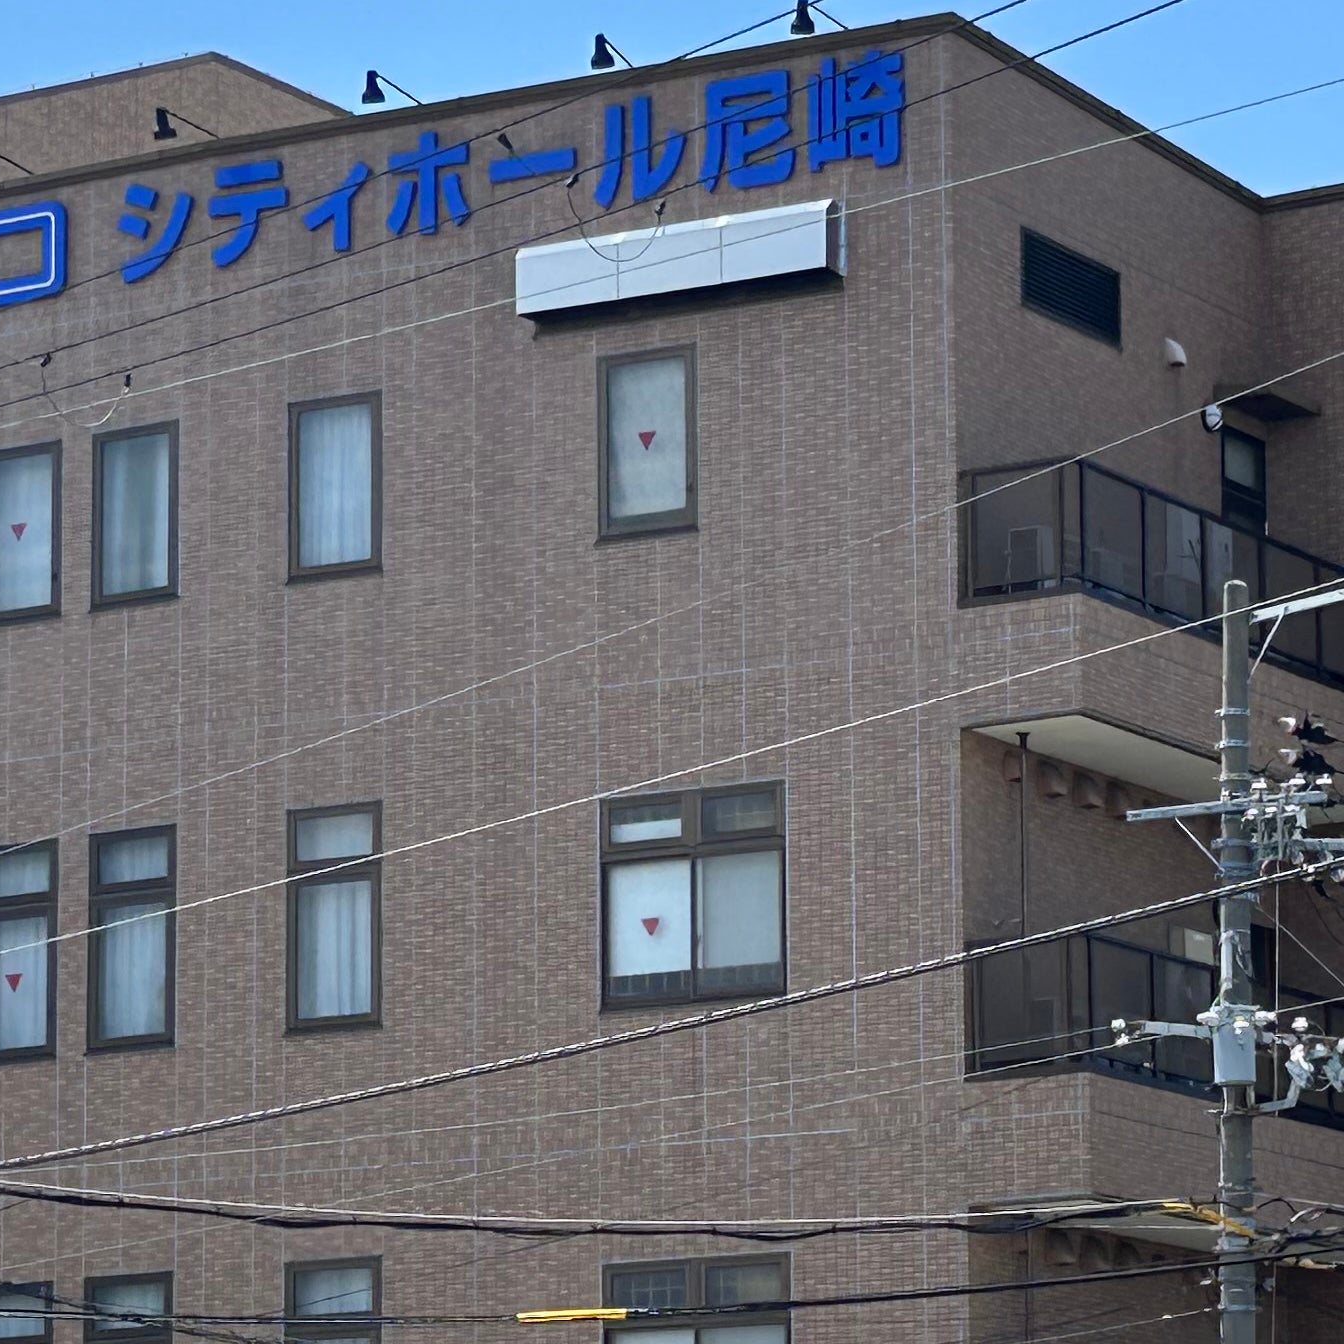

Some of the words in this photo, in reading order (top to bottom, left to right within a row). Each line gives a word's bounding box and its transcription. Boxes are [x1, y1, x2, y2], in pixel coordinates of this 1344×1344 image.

[117, 50, 907, 285] シティホール尼崎
